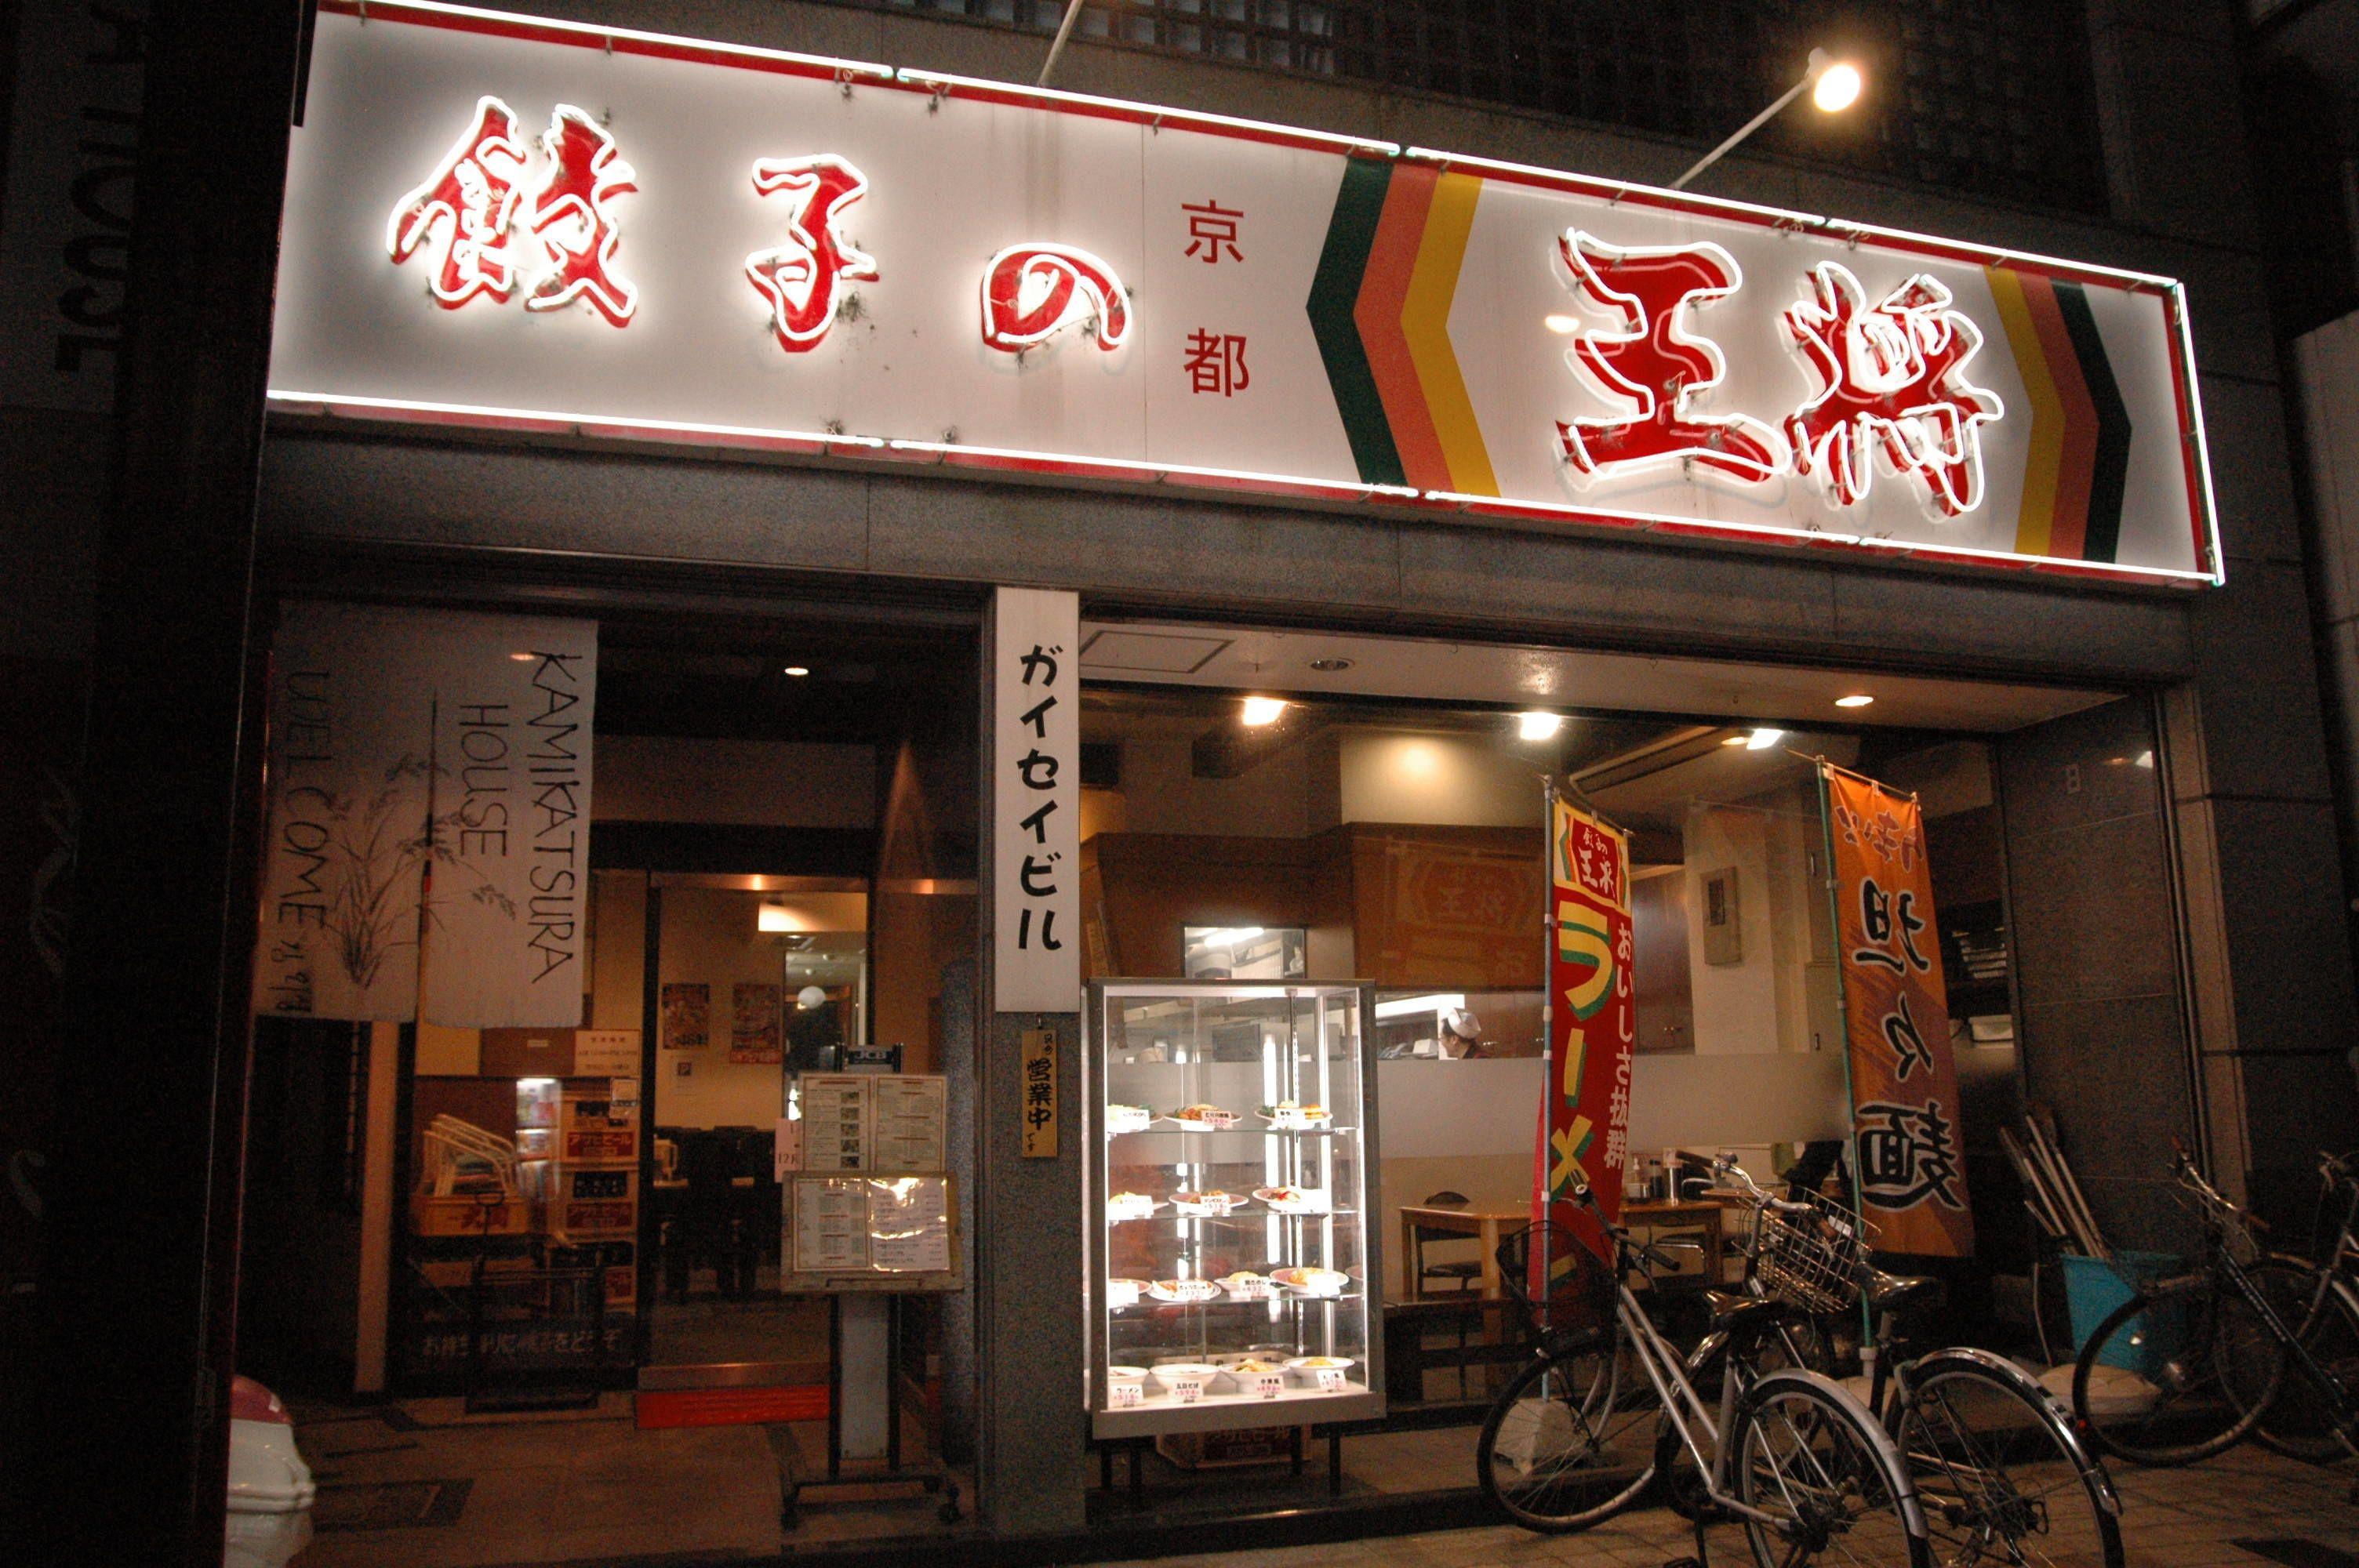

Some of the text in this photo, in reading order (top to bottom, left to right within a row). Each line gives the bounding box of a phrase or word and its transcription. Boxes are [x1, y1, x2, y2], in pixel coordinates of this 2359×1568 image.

[387, 95, 1133, 353] 餃子の
[1181, 199, 1249, 397] 京都
[1554, 227, 2005, 517] 王将
[460, 705, 509, 857] HOUSE
[526, 650, 583, 984] KAMIKATSURA
[1016, 644, 1064, 952] ガイセイビル
[1027, 1057, 1052, 1131] 営業中
[1604, 921, 1634, 1170] おいしさ抜群
